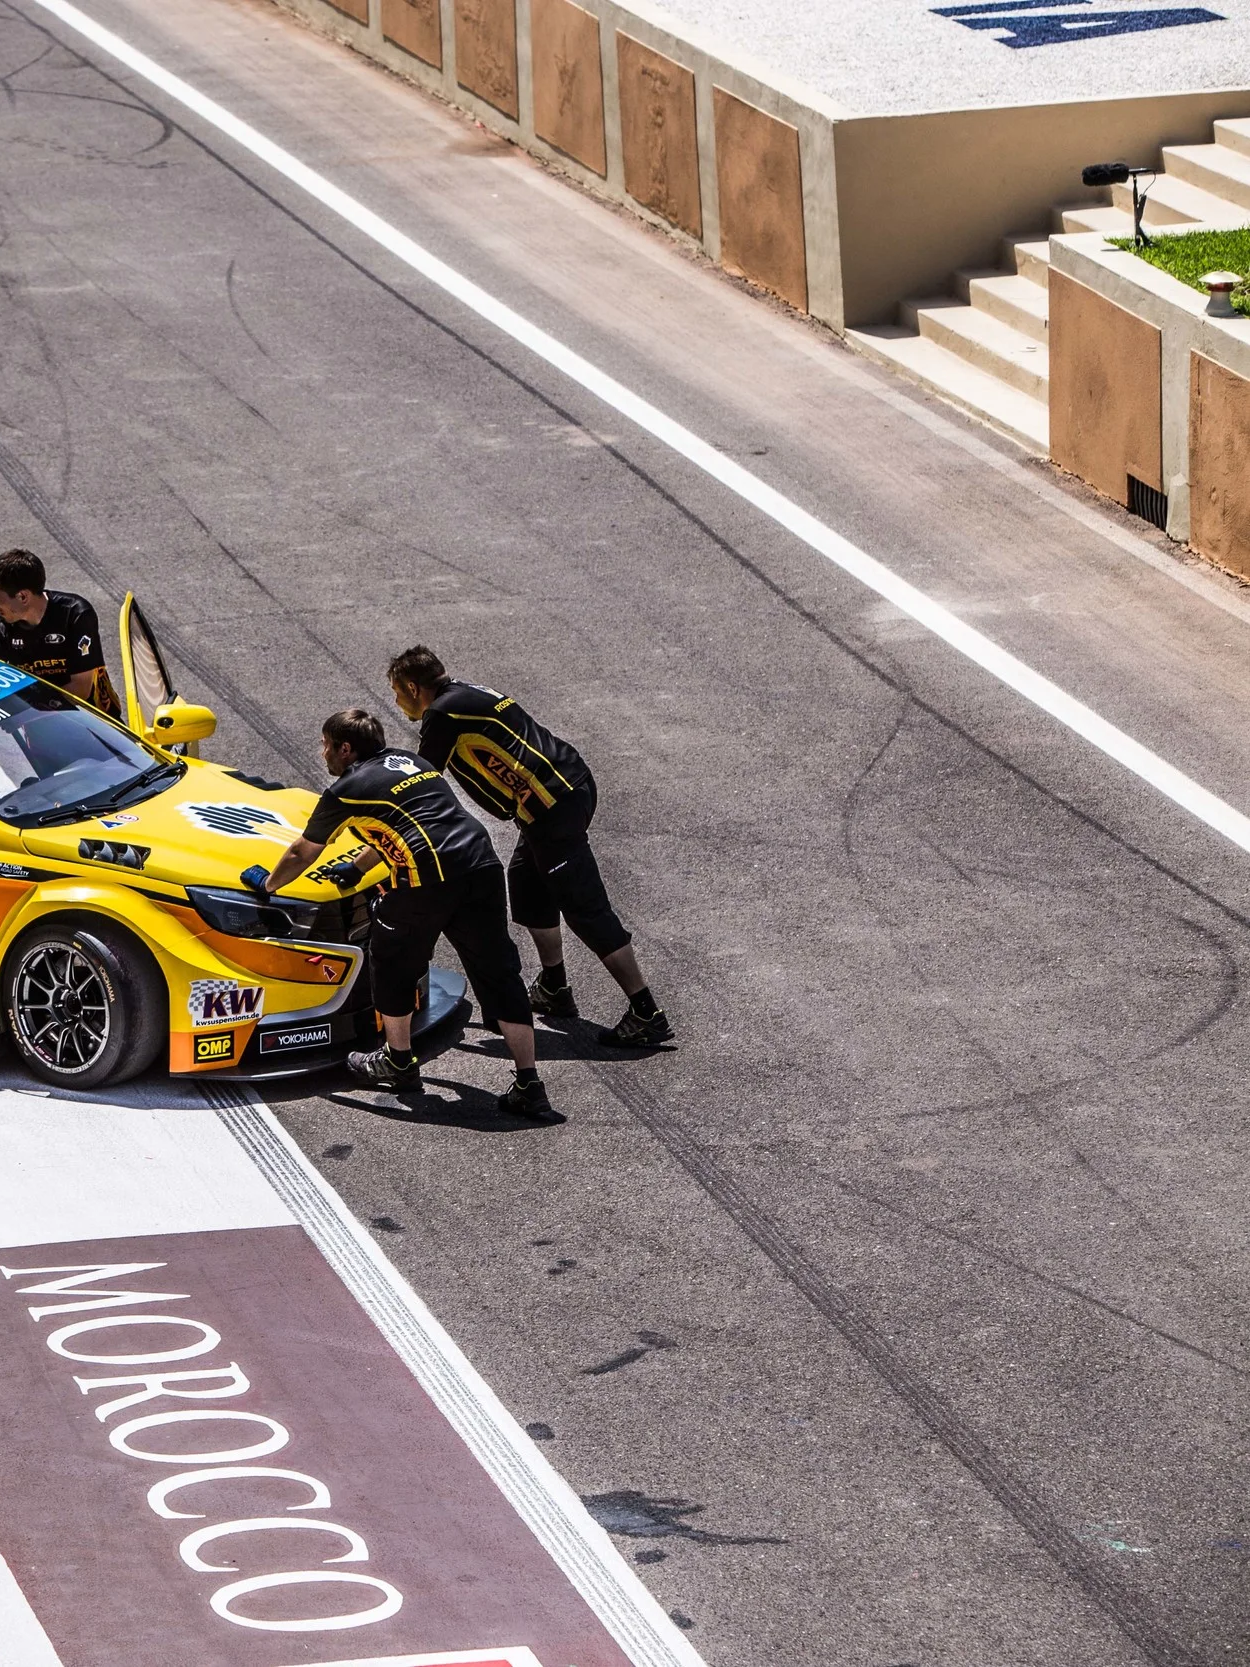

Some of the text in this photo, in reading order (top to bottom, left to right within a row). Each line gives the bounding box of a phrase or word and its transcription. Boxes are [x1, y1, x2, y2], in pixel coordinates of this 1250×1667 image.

[202, 986, 264, 1019] KW
[195, 1012, 260, 1027] kwsuspensions.de
[277, 1030, 328, 1045] YOKOHAMA
[197, 1040, 231, 1056] OMP
[0, 1262, 404, 1631] MOROCCO
